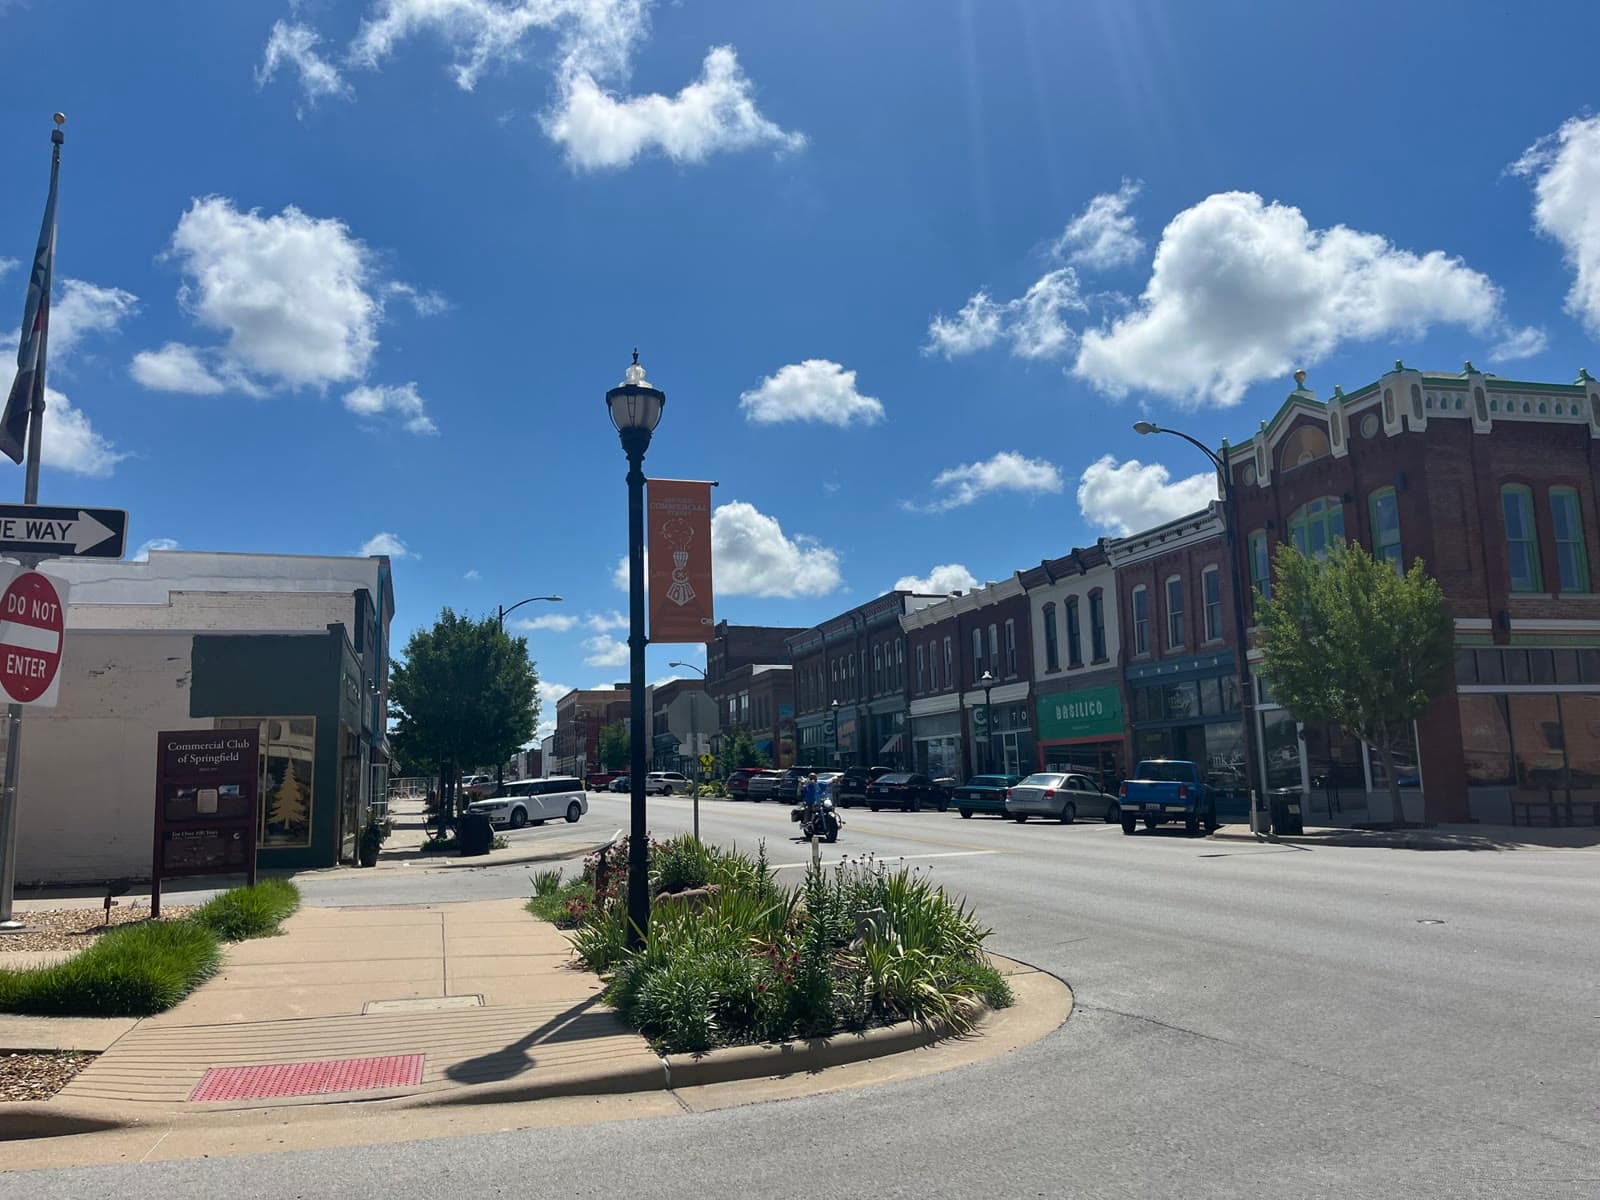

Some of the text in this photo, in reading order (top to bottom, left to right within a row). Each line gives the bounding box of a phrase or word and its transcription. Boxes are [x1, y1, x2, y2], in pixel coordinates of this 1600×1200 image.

[26, 521, 72, 541] WAY
[8, 593, 57, 623] DO NOT
[6, 654, 46, 679] ENTER
[1056, 700, 1102, 720] BASILICO
[168, 738, 250, 751] Commercial Club
[177, 752, 239, 765] of Springfield
